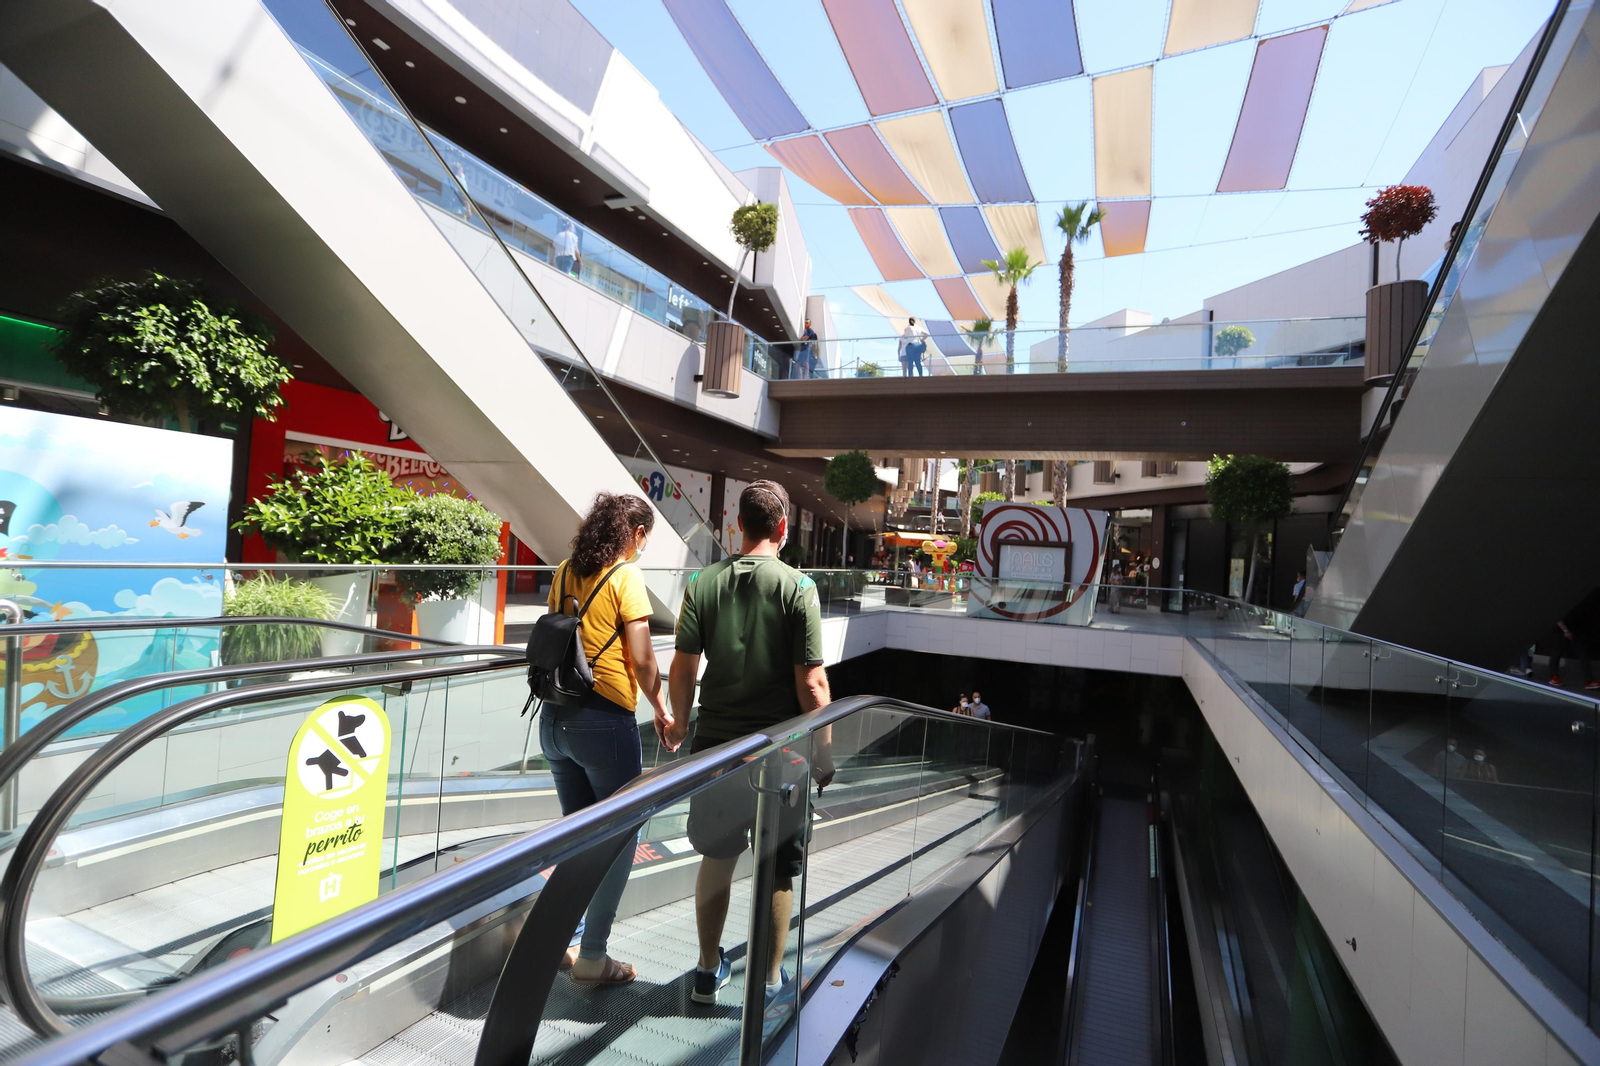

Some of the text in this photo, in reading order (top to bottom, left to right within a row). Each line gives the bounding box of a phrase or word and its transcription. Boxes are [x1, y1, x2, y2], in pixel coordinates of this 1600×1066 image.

[315, 805, 359, 822] Coge en
[306, 815, 365, 838] brazos a tu
[303, 823, 364, 866] perrito
